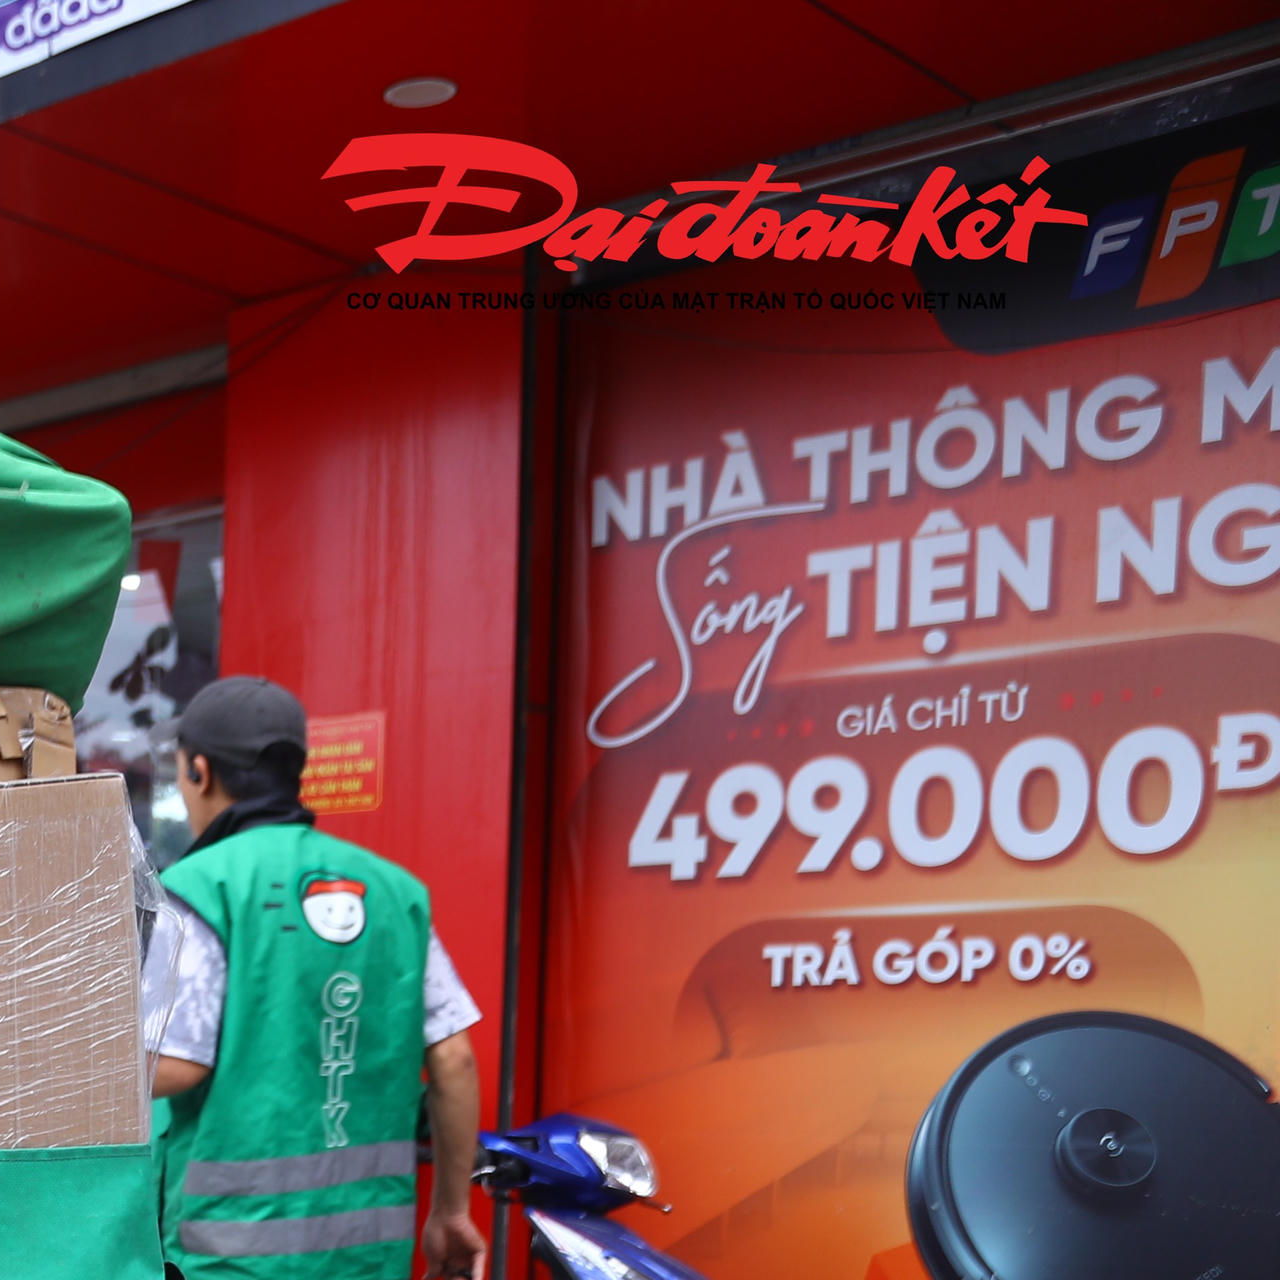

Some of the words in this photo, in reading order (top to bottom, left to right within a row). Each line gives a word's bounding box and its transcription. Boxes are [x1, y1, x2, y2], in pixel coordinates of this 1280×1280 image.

[1083, 183, 1280, 277] FPT
[591, 431, 766, 547] NHÀ
[792, 374, 1164, 505] THÔNG
[586, 502, 825, 750] Sống
[807, 507, 1055, 655] TIỆN
[836, 694, 897, 738] GIÁ
[907, 687, 971, 733] CHỈ
[978, 682, 1030, 724] TỪ
[762, 929, 860, 988] TRẢ
[872, 927, 995, 986] GÓP
[1008, 933, 1092, 982] 0%
[320, 971, 363, 1148] GHTK
